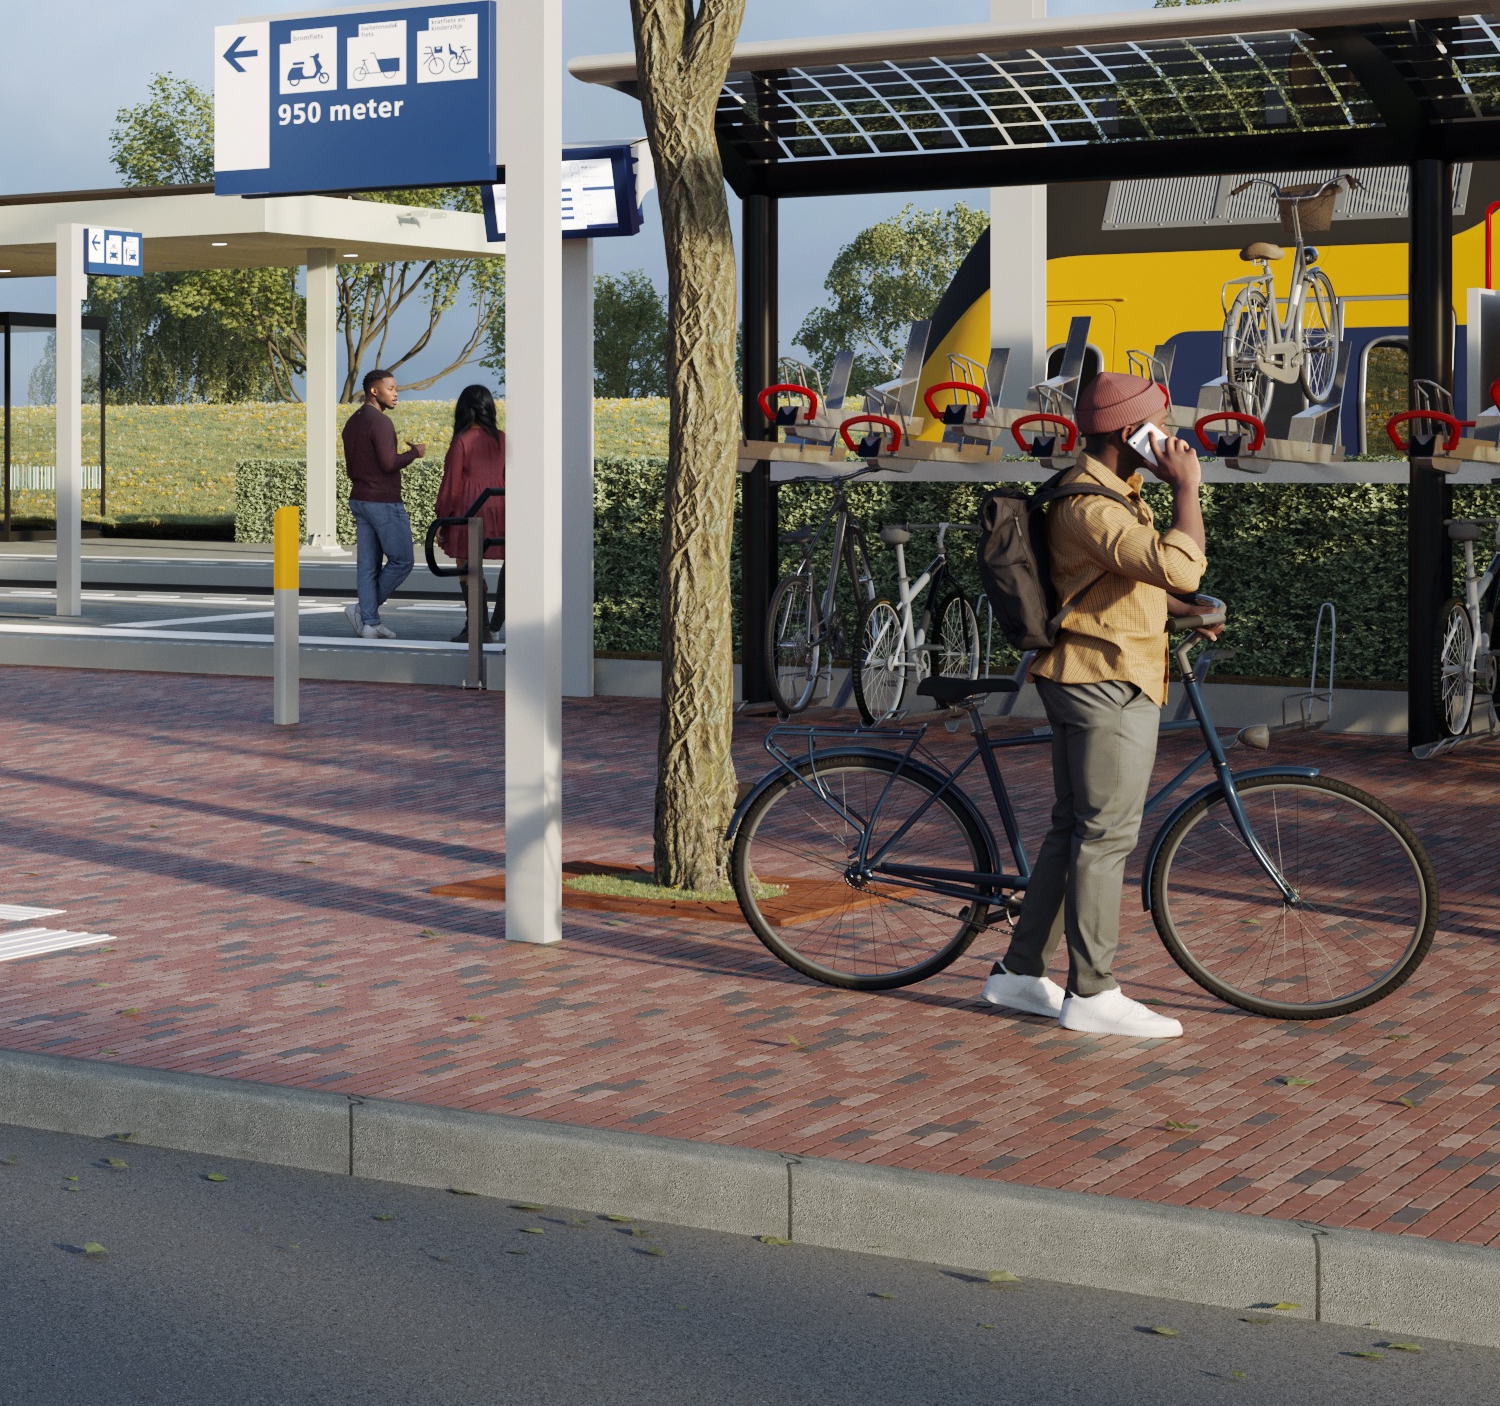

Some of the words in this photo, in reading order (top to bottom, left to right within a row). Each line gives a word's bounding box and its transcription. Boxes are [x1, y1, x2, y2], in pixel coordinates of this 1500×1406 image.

[293, 33, 324, 42] bromfiets
[278, 101, 321, 126] 950
[329, 99, 404, 122] meter
